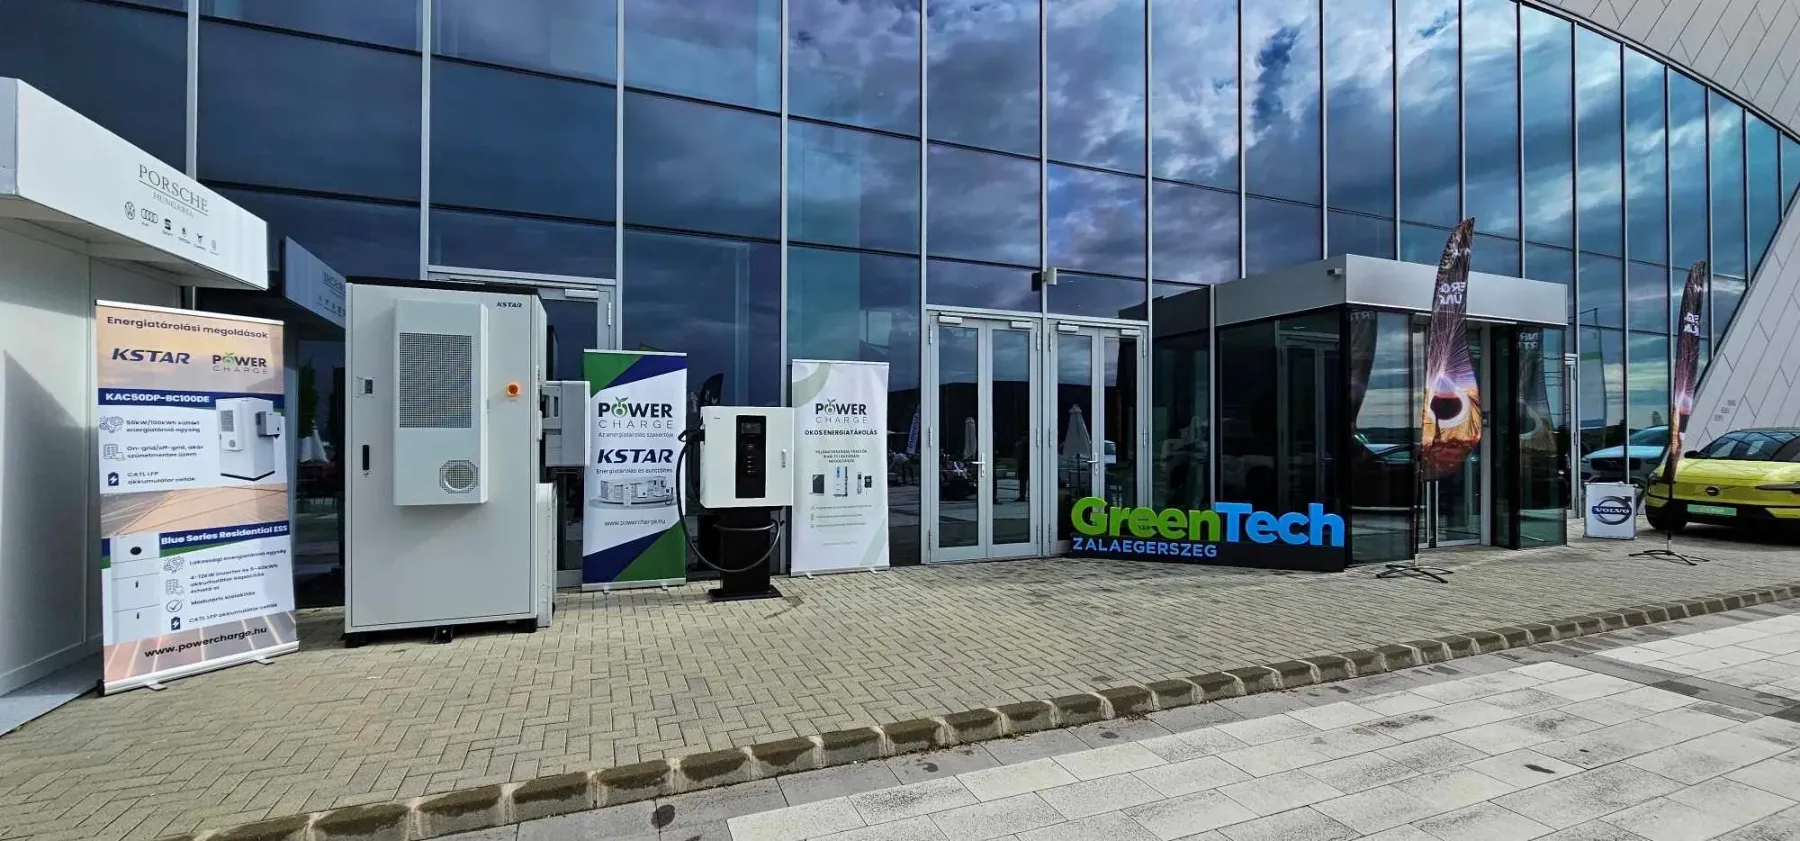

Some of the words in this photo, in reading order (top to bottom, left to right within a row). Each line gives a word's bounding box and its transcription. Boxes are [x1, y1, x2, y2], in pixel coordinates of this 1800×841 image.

[139, 163, 208, 212] PORSCHE
[107, 316, 200, 332] Energiatárolási
[203, 326, 268, 339] megoldások
[112, 348, 190, 365] KSTAR
[212, 353, 267, 368] POWER
[212, 366, 268, 375] CHARGE
[598, 402, 673, 418] POWER
[815, 403, 867, 416] POWER
[598, 420, 673, 429] CHARGE
[815, 416, 868, 424] CHARGE
[823, 428, 878, 436] ENERGIATÁROLÁS
[597, 449, 674, 464] KSTAR
[161, 537, 185, 545] Blue
[186, 533, 218, 543] Series
[219, 526, 273, 539] Residential
[273, 525, 288, 533] ESS
[1072, 537, 1217, 558] ZALAEGERSZEG
[144, 627, 267, 658] www.powercharge.hu
